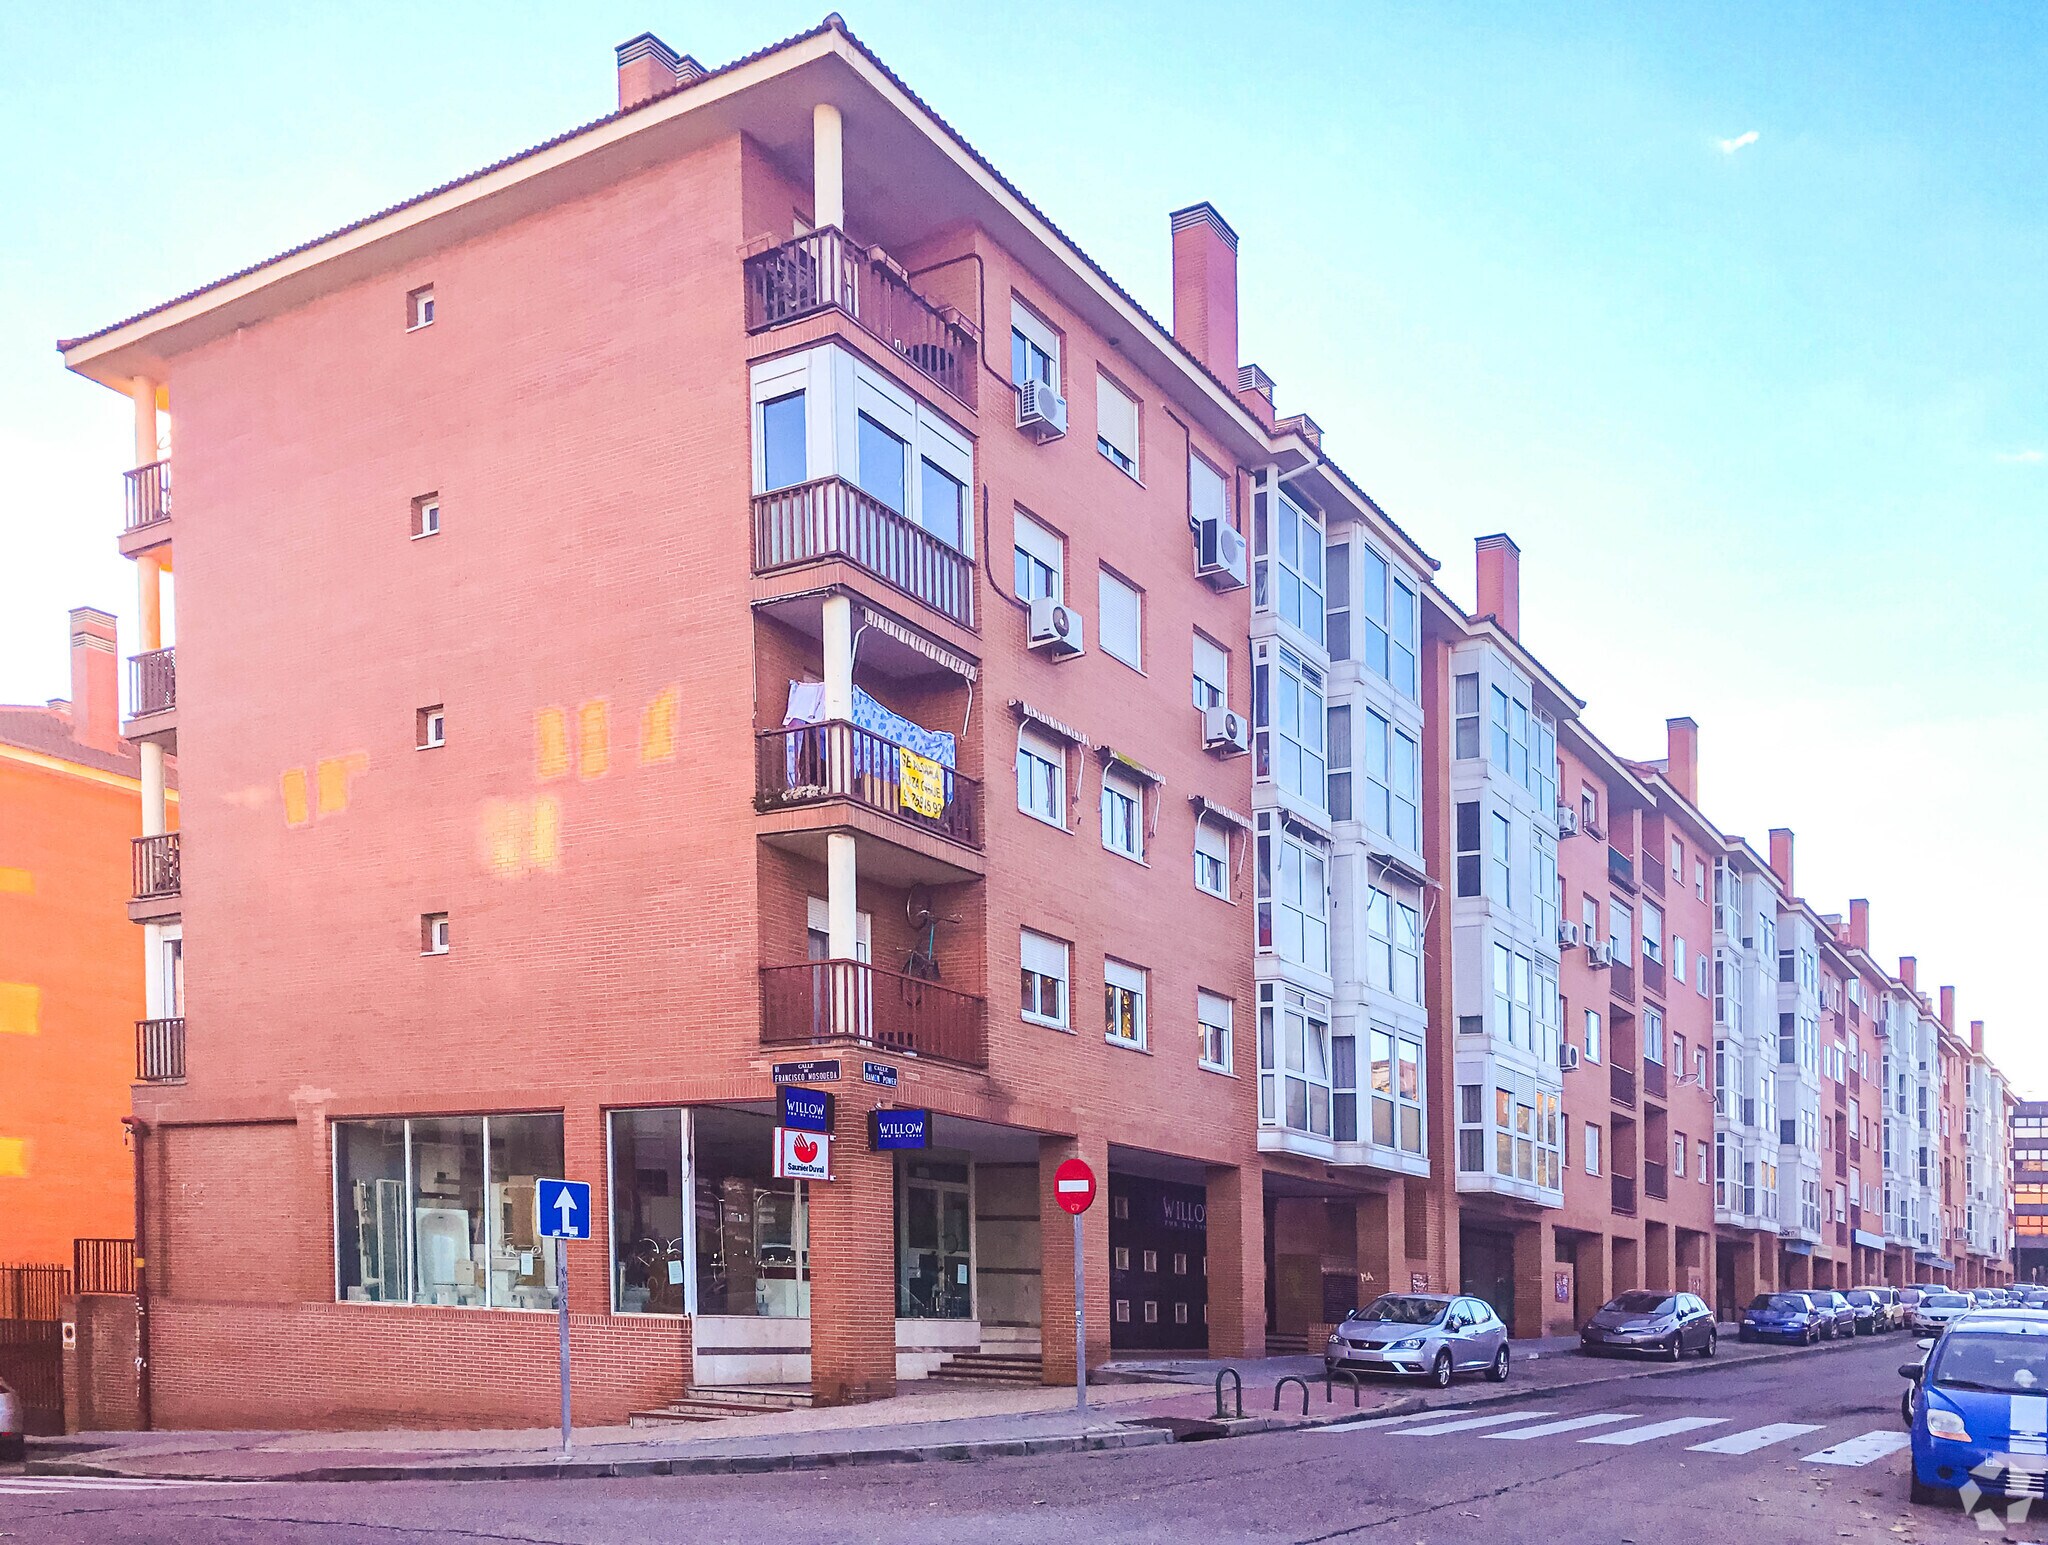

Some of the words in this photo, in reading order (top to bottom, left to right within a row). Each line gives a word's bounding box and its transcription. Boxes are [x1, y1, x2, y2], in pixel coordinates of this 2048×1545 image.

[775, 1073, 805, 1082] FRANCISCO
[786, 1099, 824, 1115] WILLOW
[879, 1121, 923, 1134] WILLOW
[1163, 1196, 1206, 1222] WILLO
